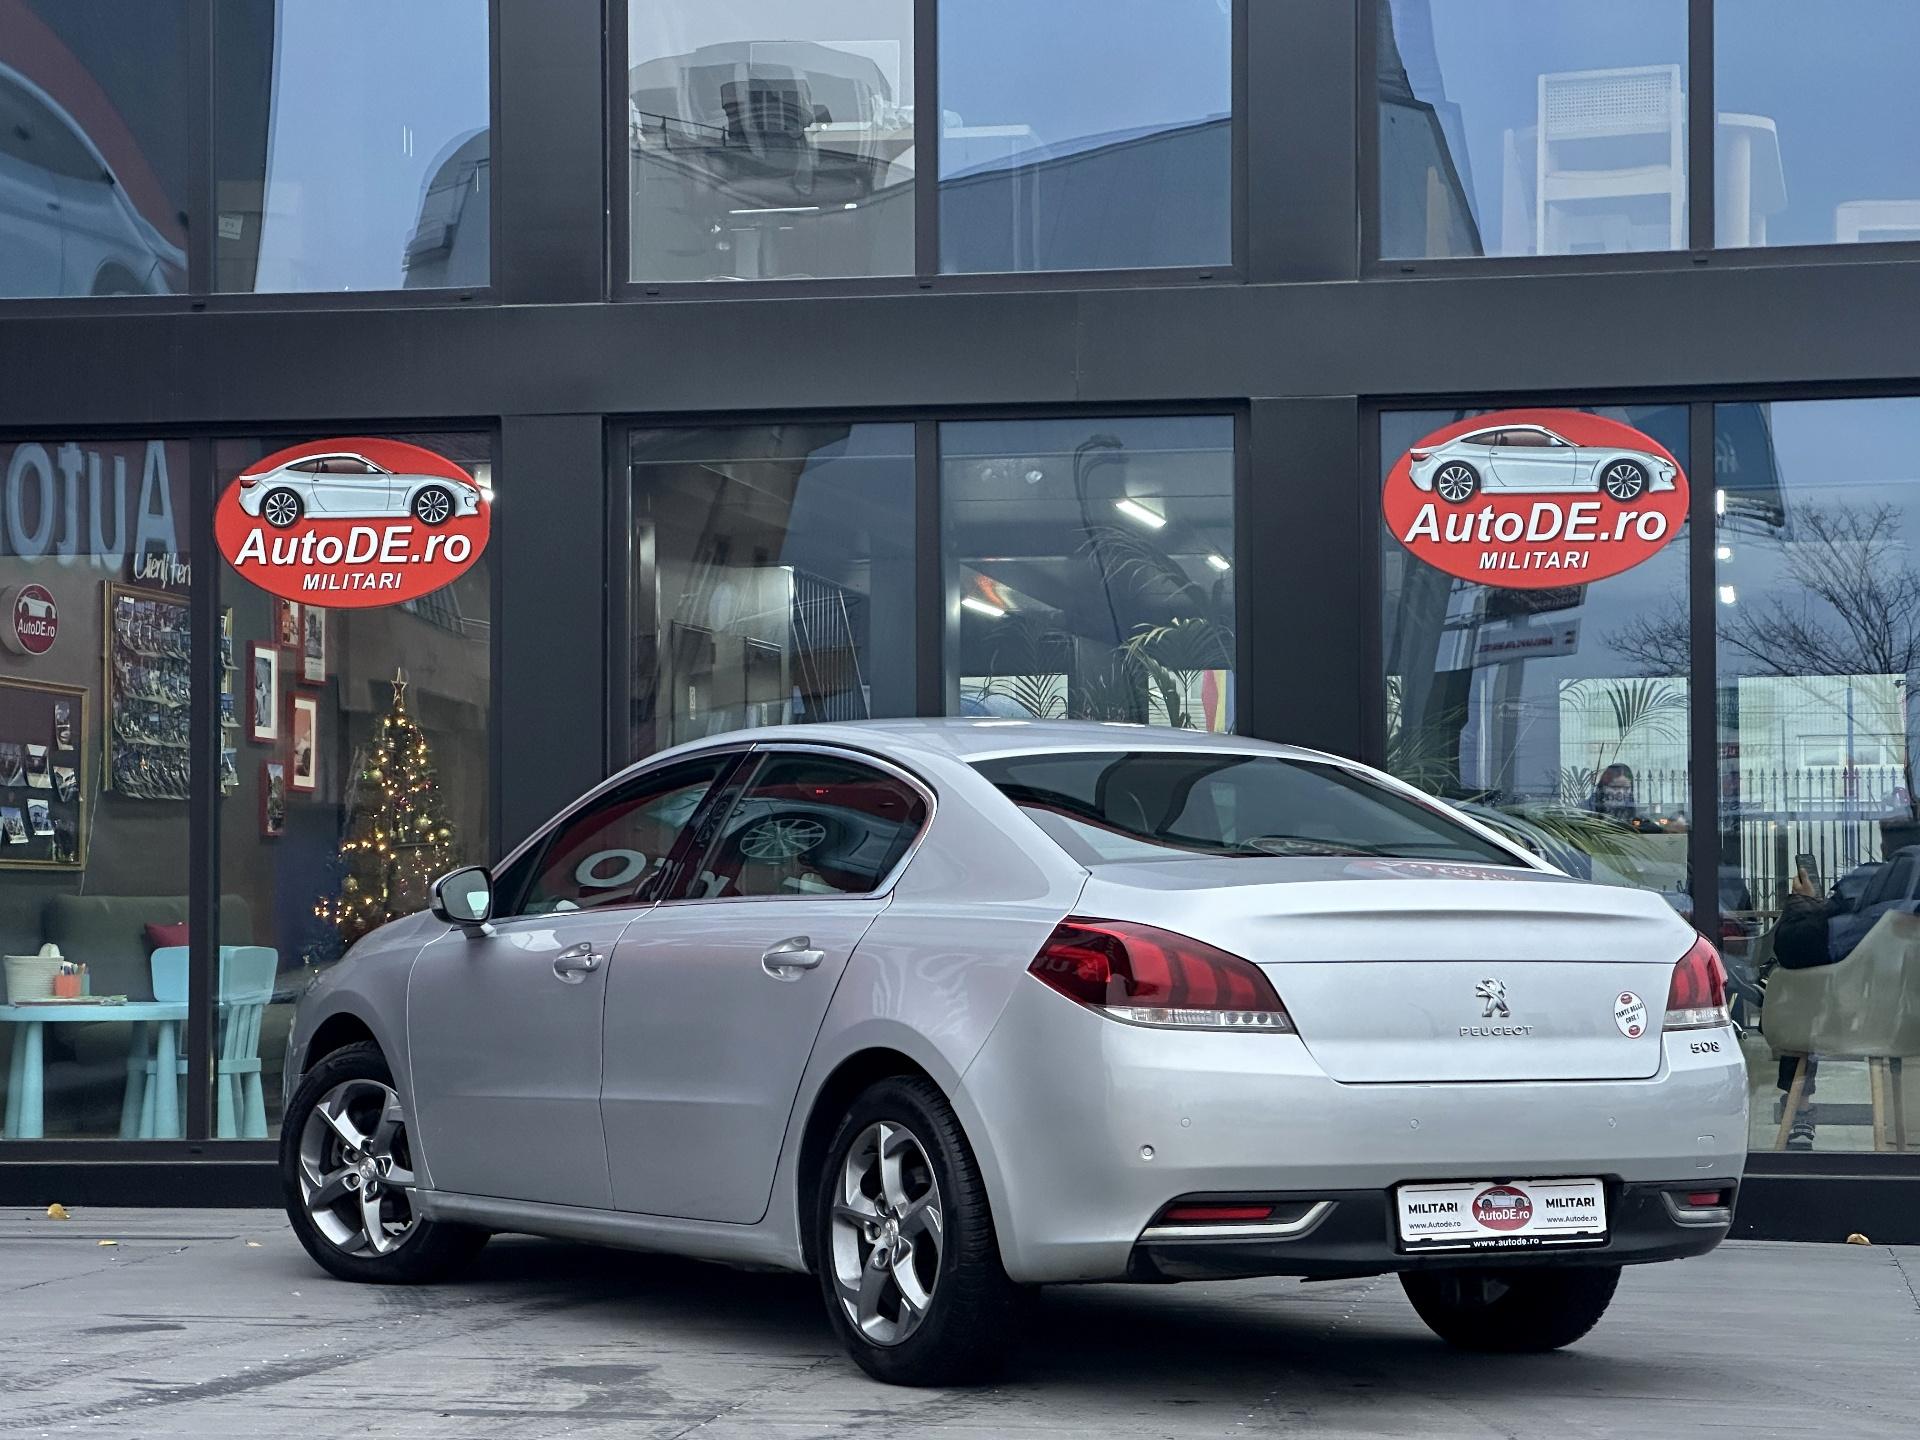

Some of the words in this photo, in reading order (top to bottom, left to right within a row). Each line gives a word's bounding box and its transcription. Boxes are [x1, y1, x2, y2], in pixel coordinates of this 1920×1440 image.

[1403, 501, 1668, 543] AutoDE.ro
[234, 525, 472, 566] AutoDE.ro
[1479, 550, 1589, 569] MILITARI
[302, 572, 402, 591] MILITARI
[17, 618, 56, 638] AutoDE.ro
[1459, 1024, 1534, 1037] PEUGEOT
[1690, 1041, 1720, 1054] 508
[1408, 1202, 1458, 1214] MILITARI
[1545, 1196, 1595, 1208] MILITARI
[1478, 1208, 1530, 1221] AutoDE.ro
[1546, 1214, 1598, 1223] www.Autode.ro
[1409, 1220, 1461, 1229] www.Autode.ro
[1473, 1237, 1540, 1248] www.autode.ro
